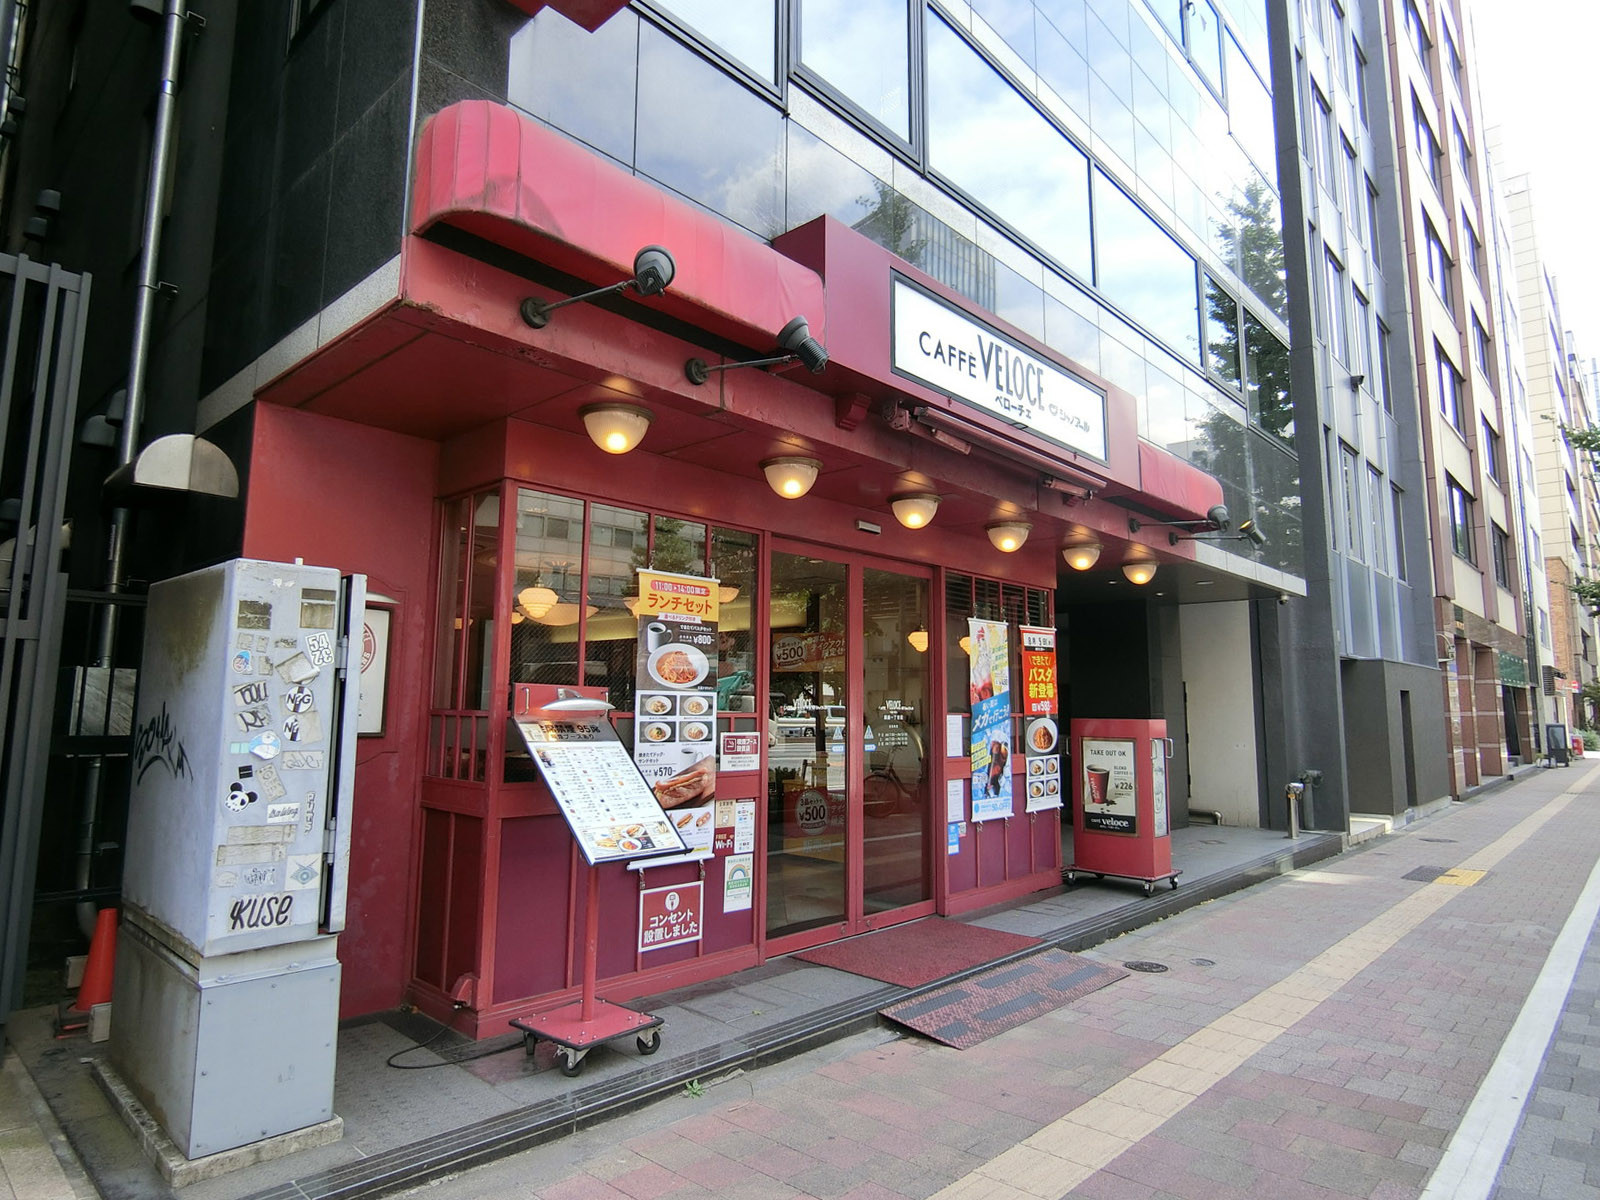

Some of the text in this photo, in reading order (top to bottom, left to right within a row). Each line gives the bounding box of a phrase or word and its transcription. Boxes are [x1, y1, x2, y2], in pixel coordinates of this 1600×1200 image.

[977, 334, 1044, 411] VELOCE
[648, 593, 713, 615] ランチセット
[308, 634, 328, 652] 54
[776, 646, 804, 660] ¥500
[1029, 667, 1053, 682] パスタ
[1028, 682, 1054, 699] 新登場
[798, 804, 826, 821] ¥500
[1101, 816, 1130, 828] veloce
[715, 838, 733, 850] Wi-Fi
[649, 908, 694, 928] コンセント
[643, 920, 698, 944] 設置しました
